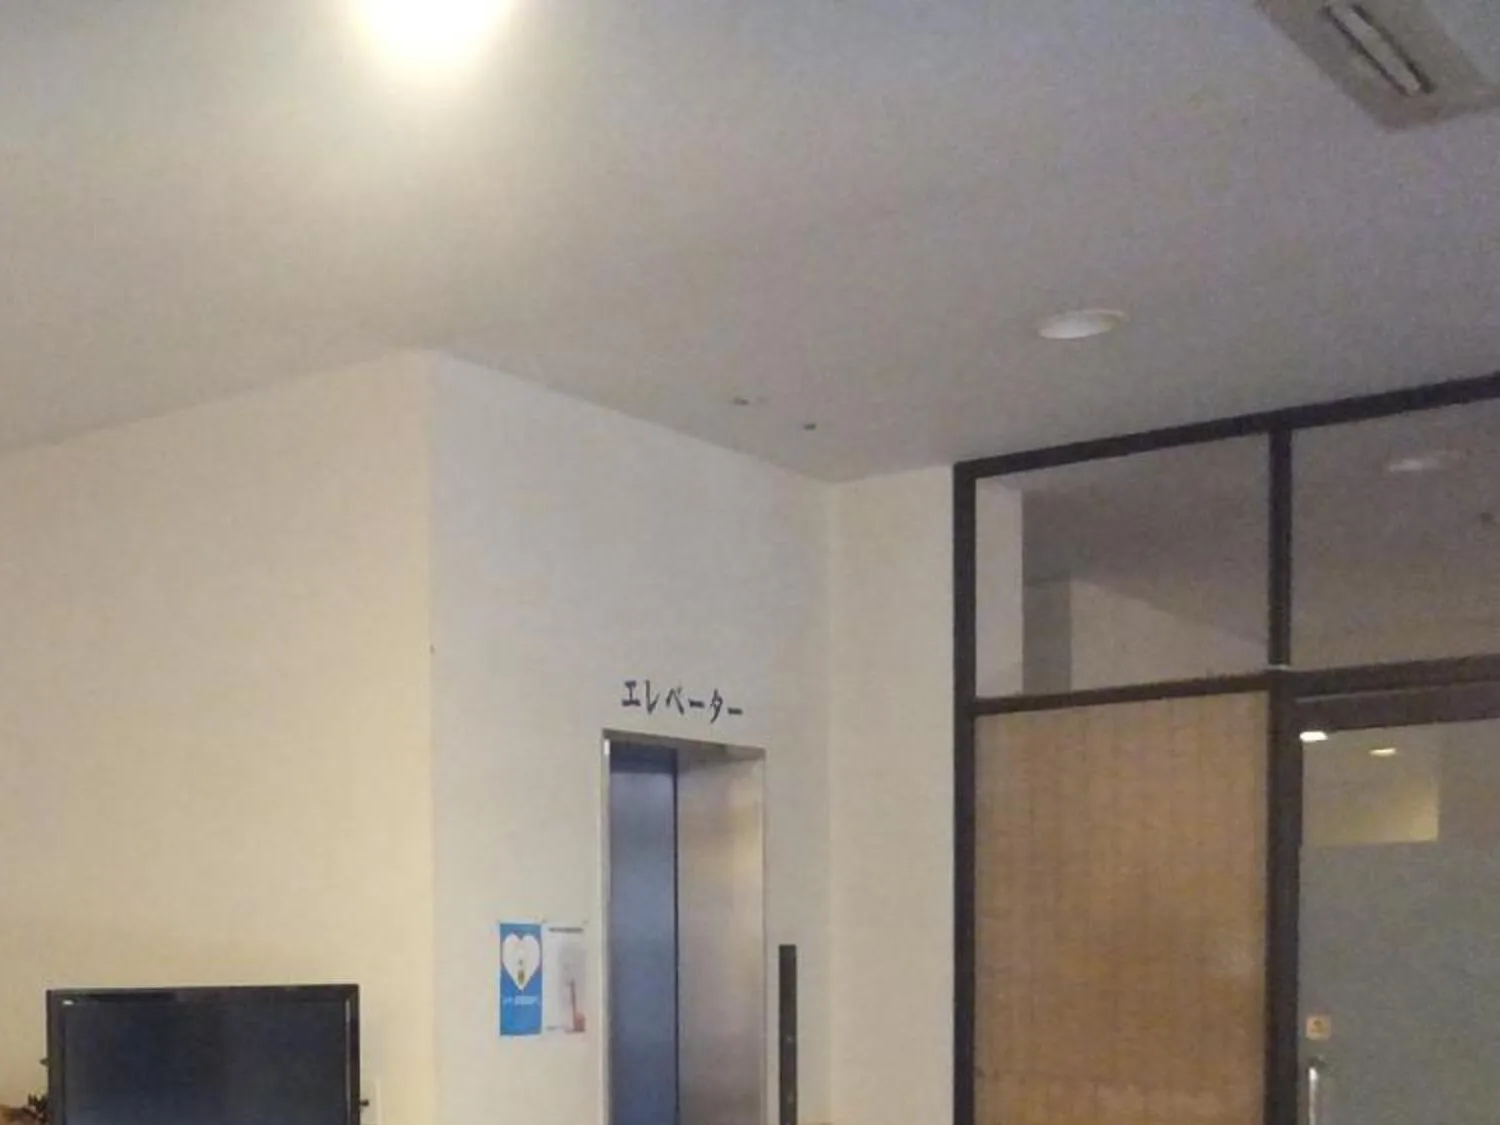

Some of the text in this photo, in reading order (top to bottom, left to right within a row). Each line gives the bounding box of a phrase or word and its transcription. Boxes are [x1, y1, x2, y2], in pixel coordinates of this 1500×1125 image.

[620, 679, 744, 725] エレベーター
